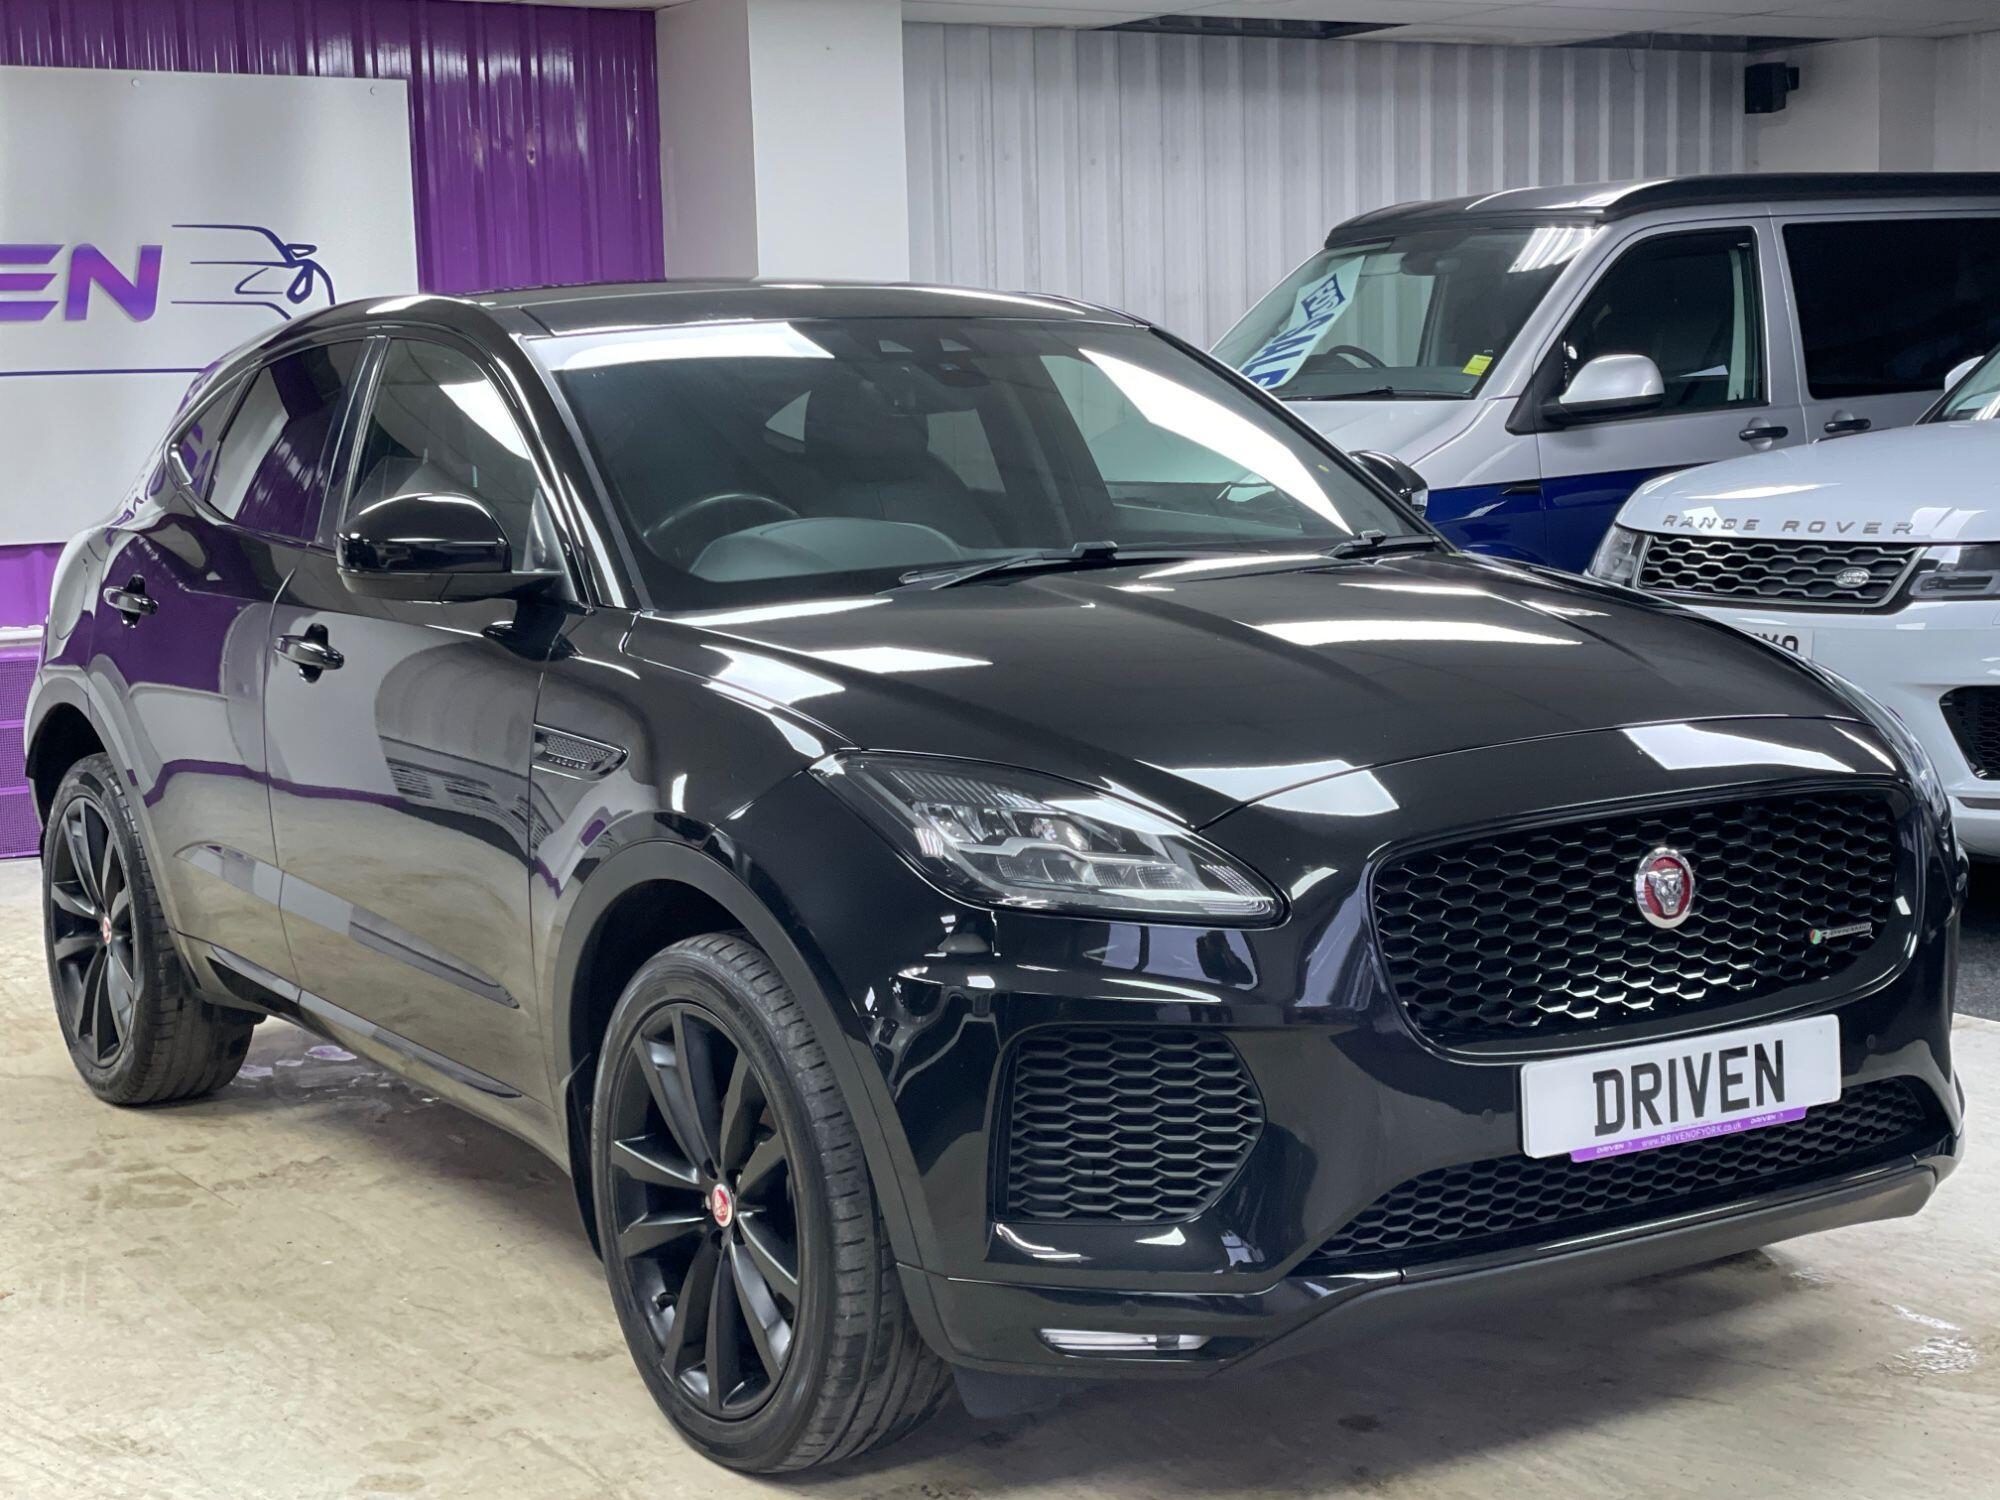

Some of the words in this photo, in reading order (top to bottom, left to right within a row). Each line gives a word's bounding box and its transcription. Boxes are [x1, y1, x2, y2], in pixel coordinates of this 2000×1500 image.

[1662, 514, 1760, 531] RANGE
[1782, 520, 1914, 535] ROVER
[1593, 1040, 1785, 1136] DRIVEN
